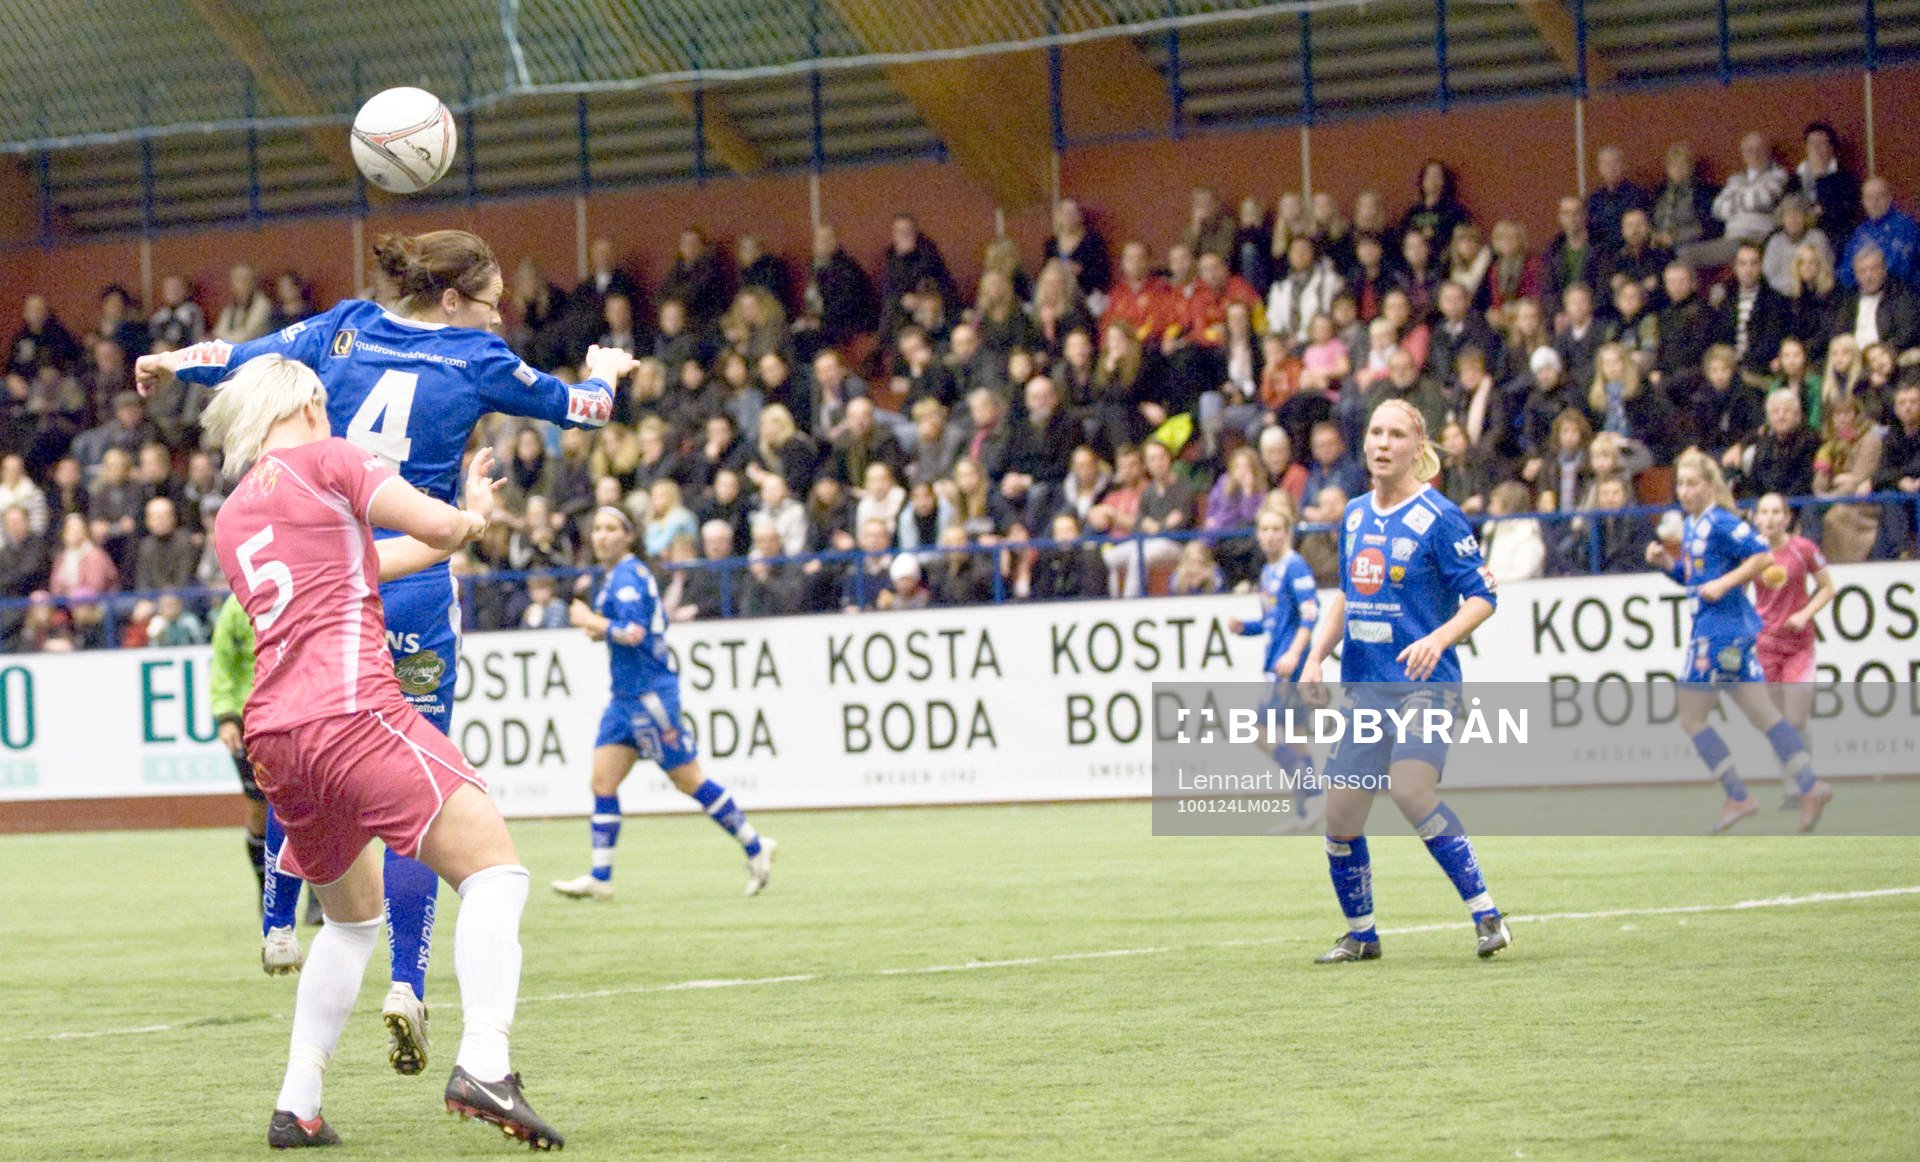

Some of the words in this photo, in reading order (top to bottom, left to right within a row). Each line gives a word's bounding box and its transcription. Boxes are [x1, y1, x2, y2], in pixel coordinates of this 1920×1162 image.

[355, 340, 467, 368] quatroworldwide.com
[346, 369, 420, 471] 4
[235, 524, 294, 632] 5
[1050, 617, 1234, 675] KOSTA
[1532, 594, 1687, 655] KOST
[454, 649, 571, 703] OSTA
[667, 638, 781, 693] STA
[827, 629, 1002, 685] KOSTA
[462, 715, 566, 769] ODA
[682, 708, 778, 760] DA
[842, 698, 998, 754] BODA
[1066, 689, 1228, 746] BODA
